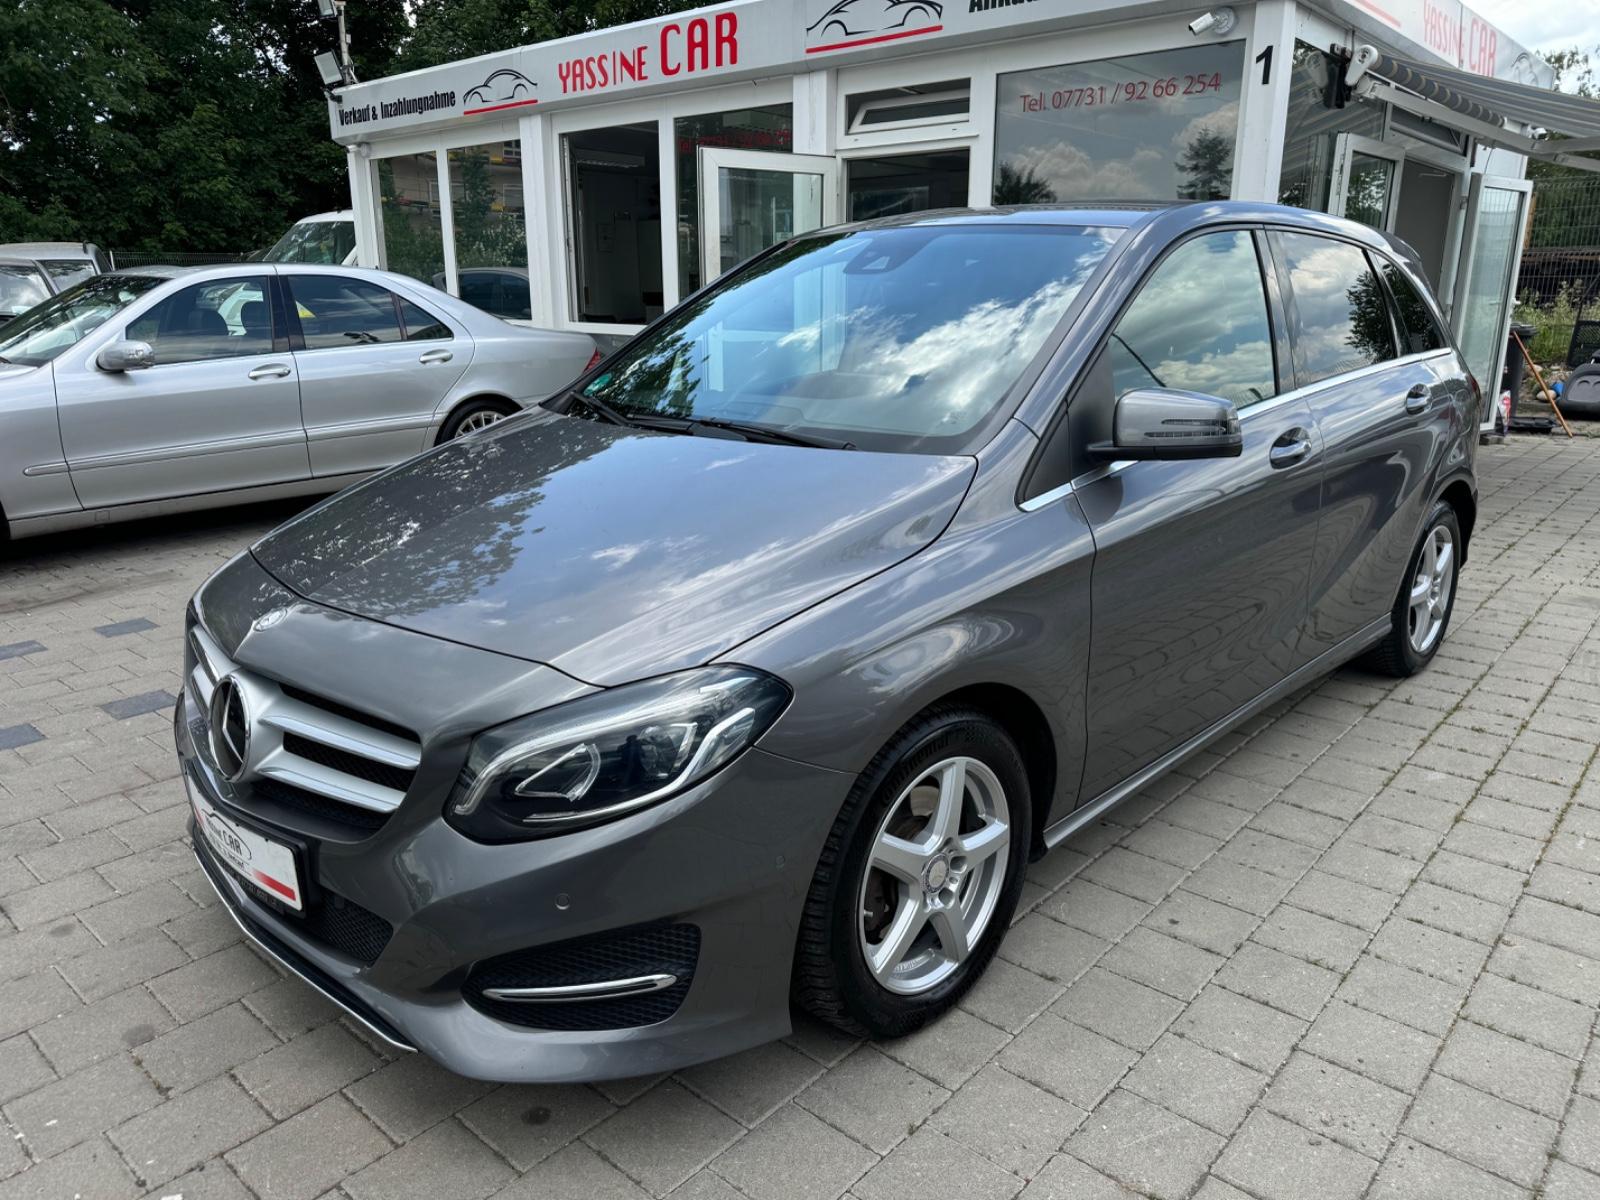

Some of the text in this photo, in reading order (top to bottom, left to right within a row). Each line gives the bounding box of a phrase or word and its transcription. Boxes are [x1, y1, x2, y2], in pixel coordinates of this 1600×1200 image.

[558, 12, 738, 93] YASSINE CAR
[1255, 45, 1274, 85] 1
[1469, 17, 1497, 78] CAR
[338, 91, 456, 126] Verkauf & Inzahlungnahme
[1020, 72, 1221, 112] Tel. 07731 / 92 66 254
